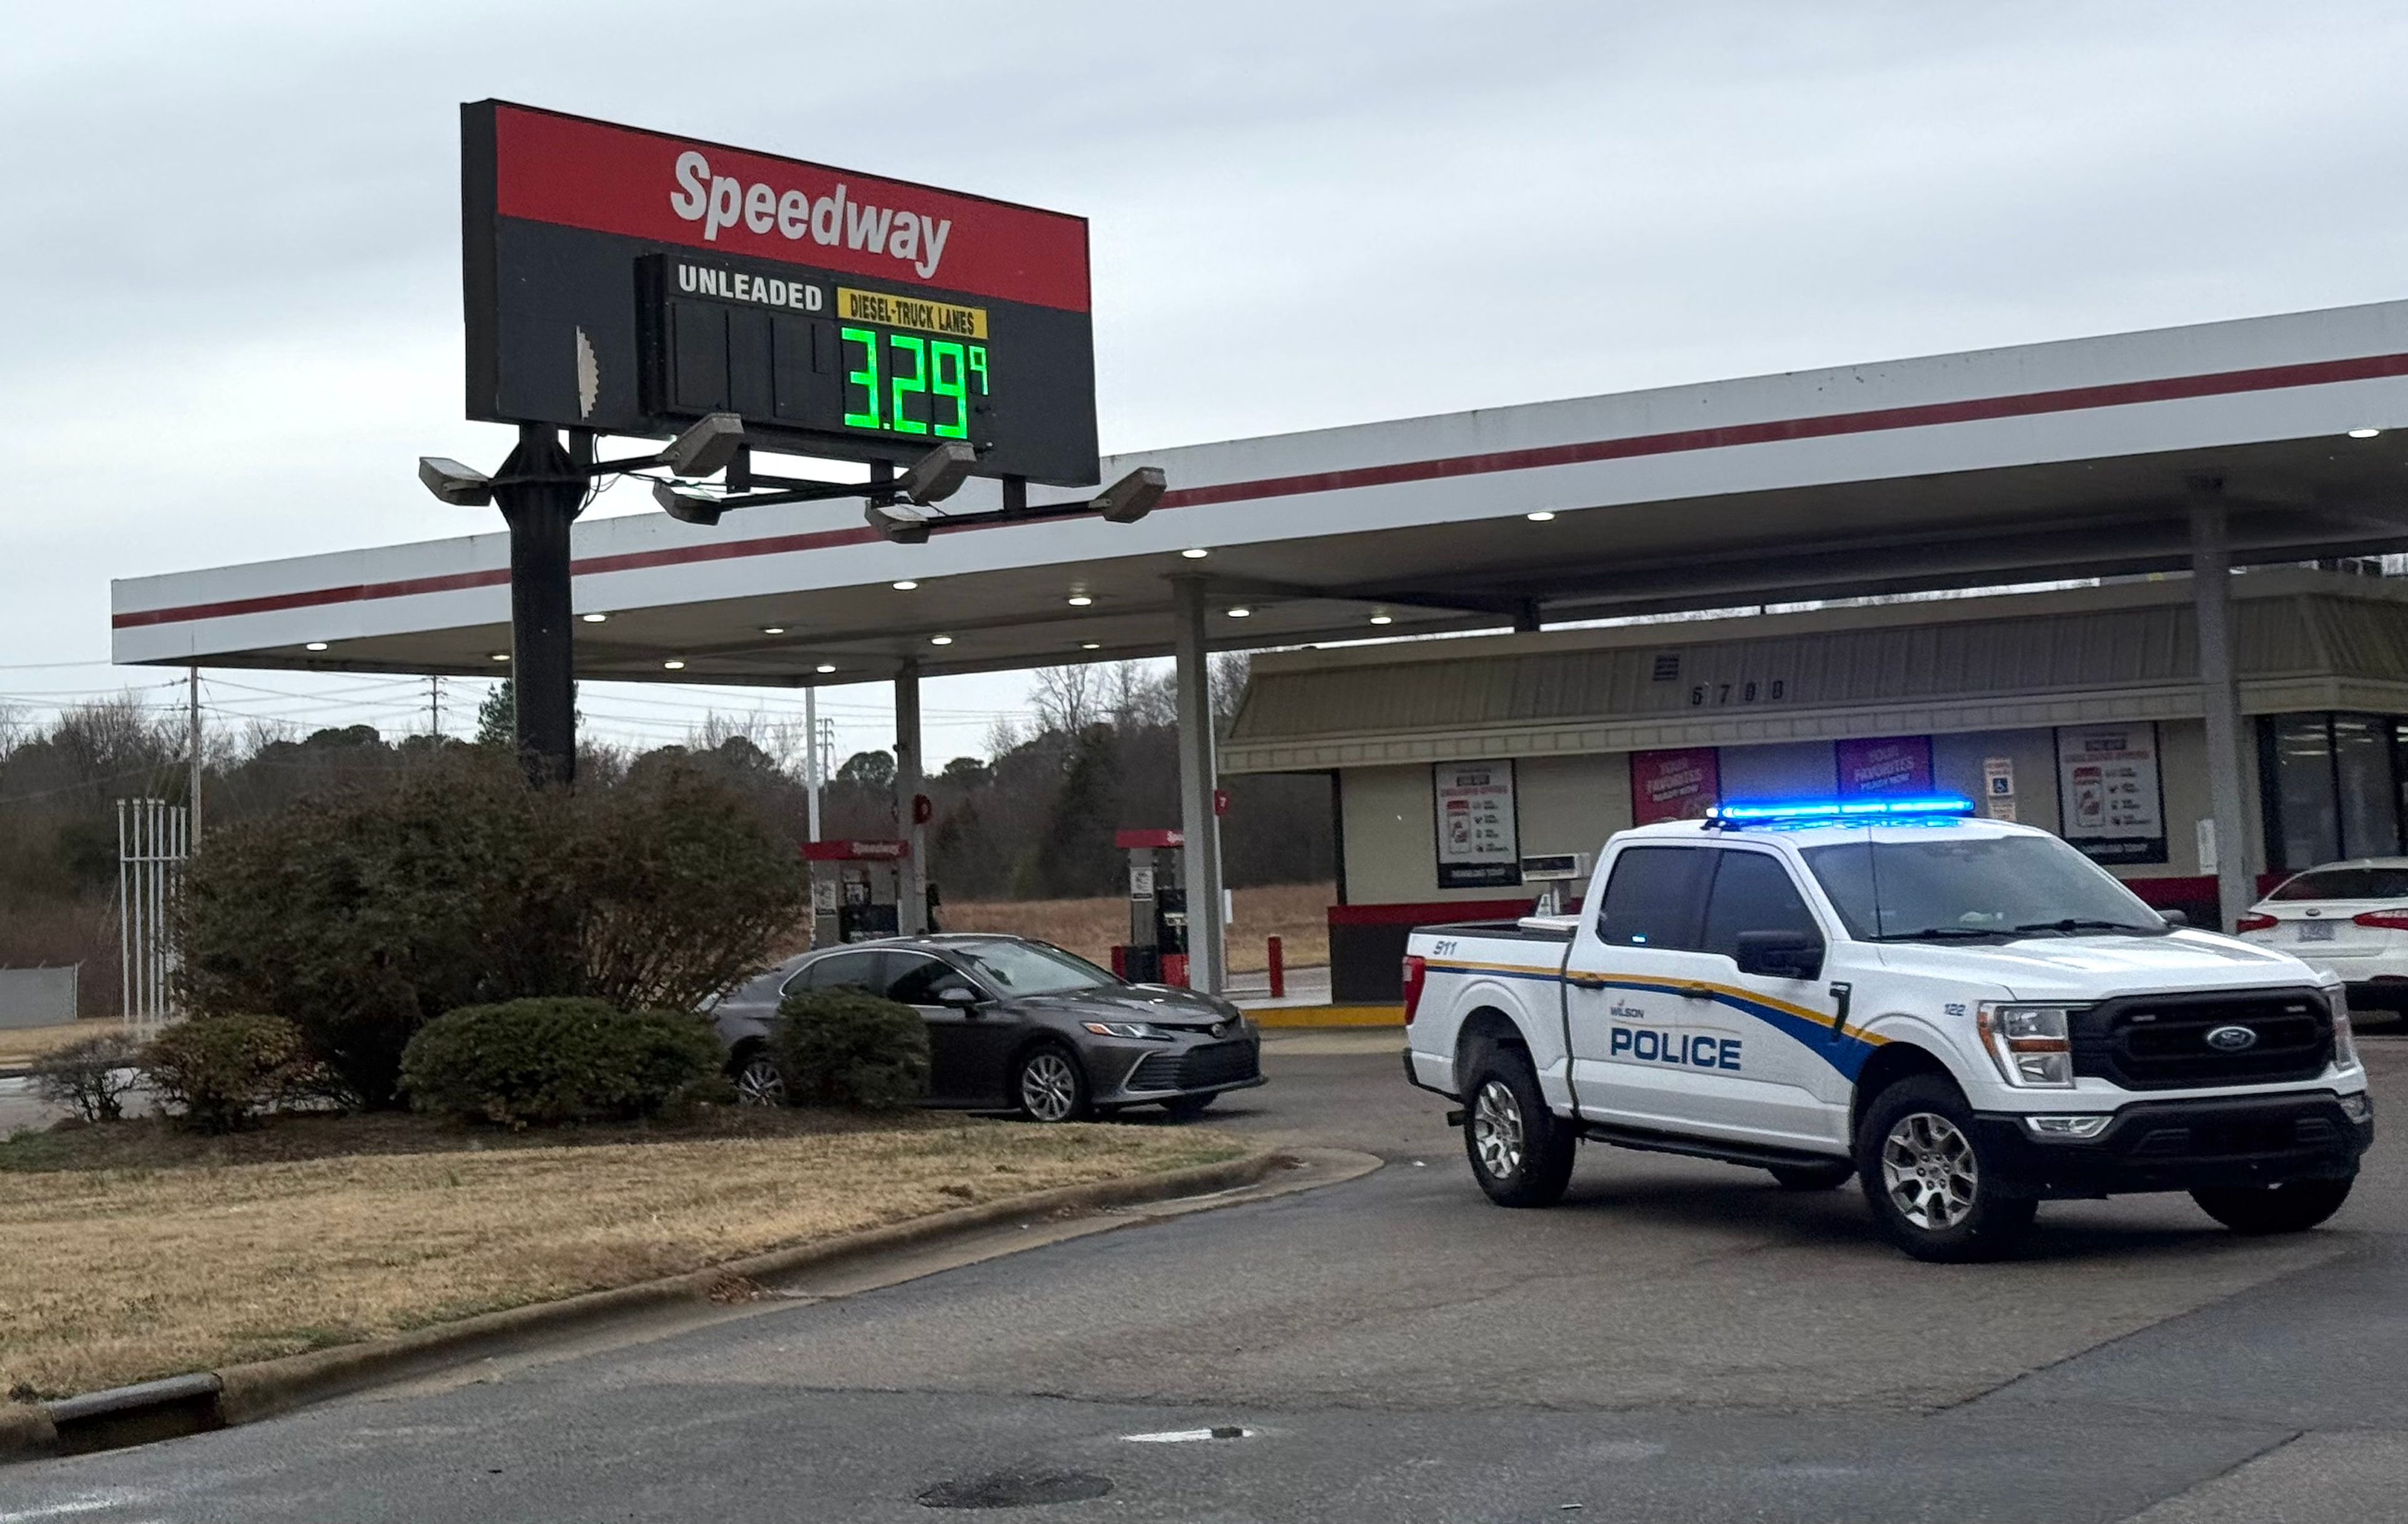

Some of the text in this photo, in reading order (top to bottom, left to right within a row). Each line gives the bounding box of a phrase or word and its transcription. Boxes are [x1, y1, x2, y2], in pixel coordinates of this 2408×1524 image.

[670, 150, 952, 280] Speedway
[678, 264, 823, 312] UNLEADED
[850, 293, 975, 335] DIESEL-TRUCK LANES
[1433, 940, 1458, 955] 911
[1610, 1006, 1645, 1019] WILSON
[1943, 1003, 1966, 1017] 122
[1610, 1027, 1743, 1071] POLICE
